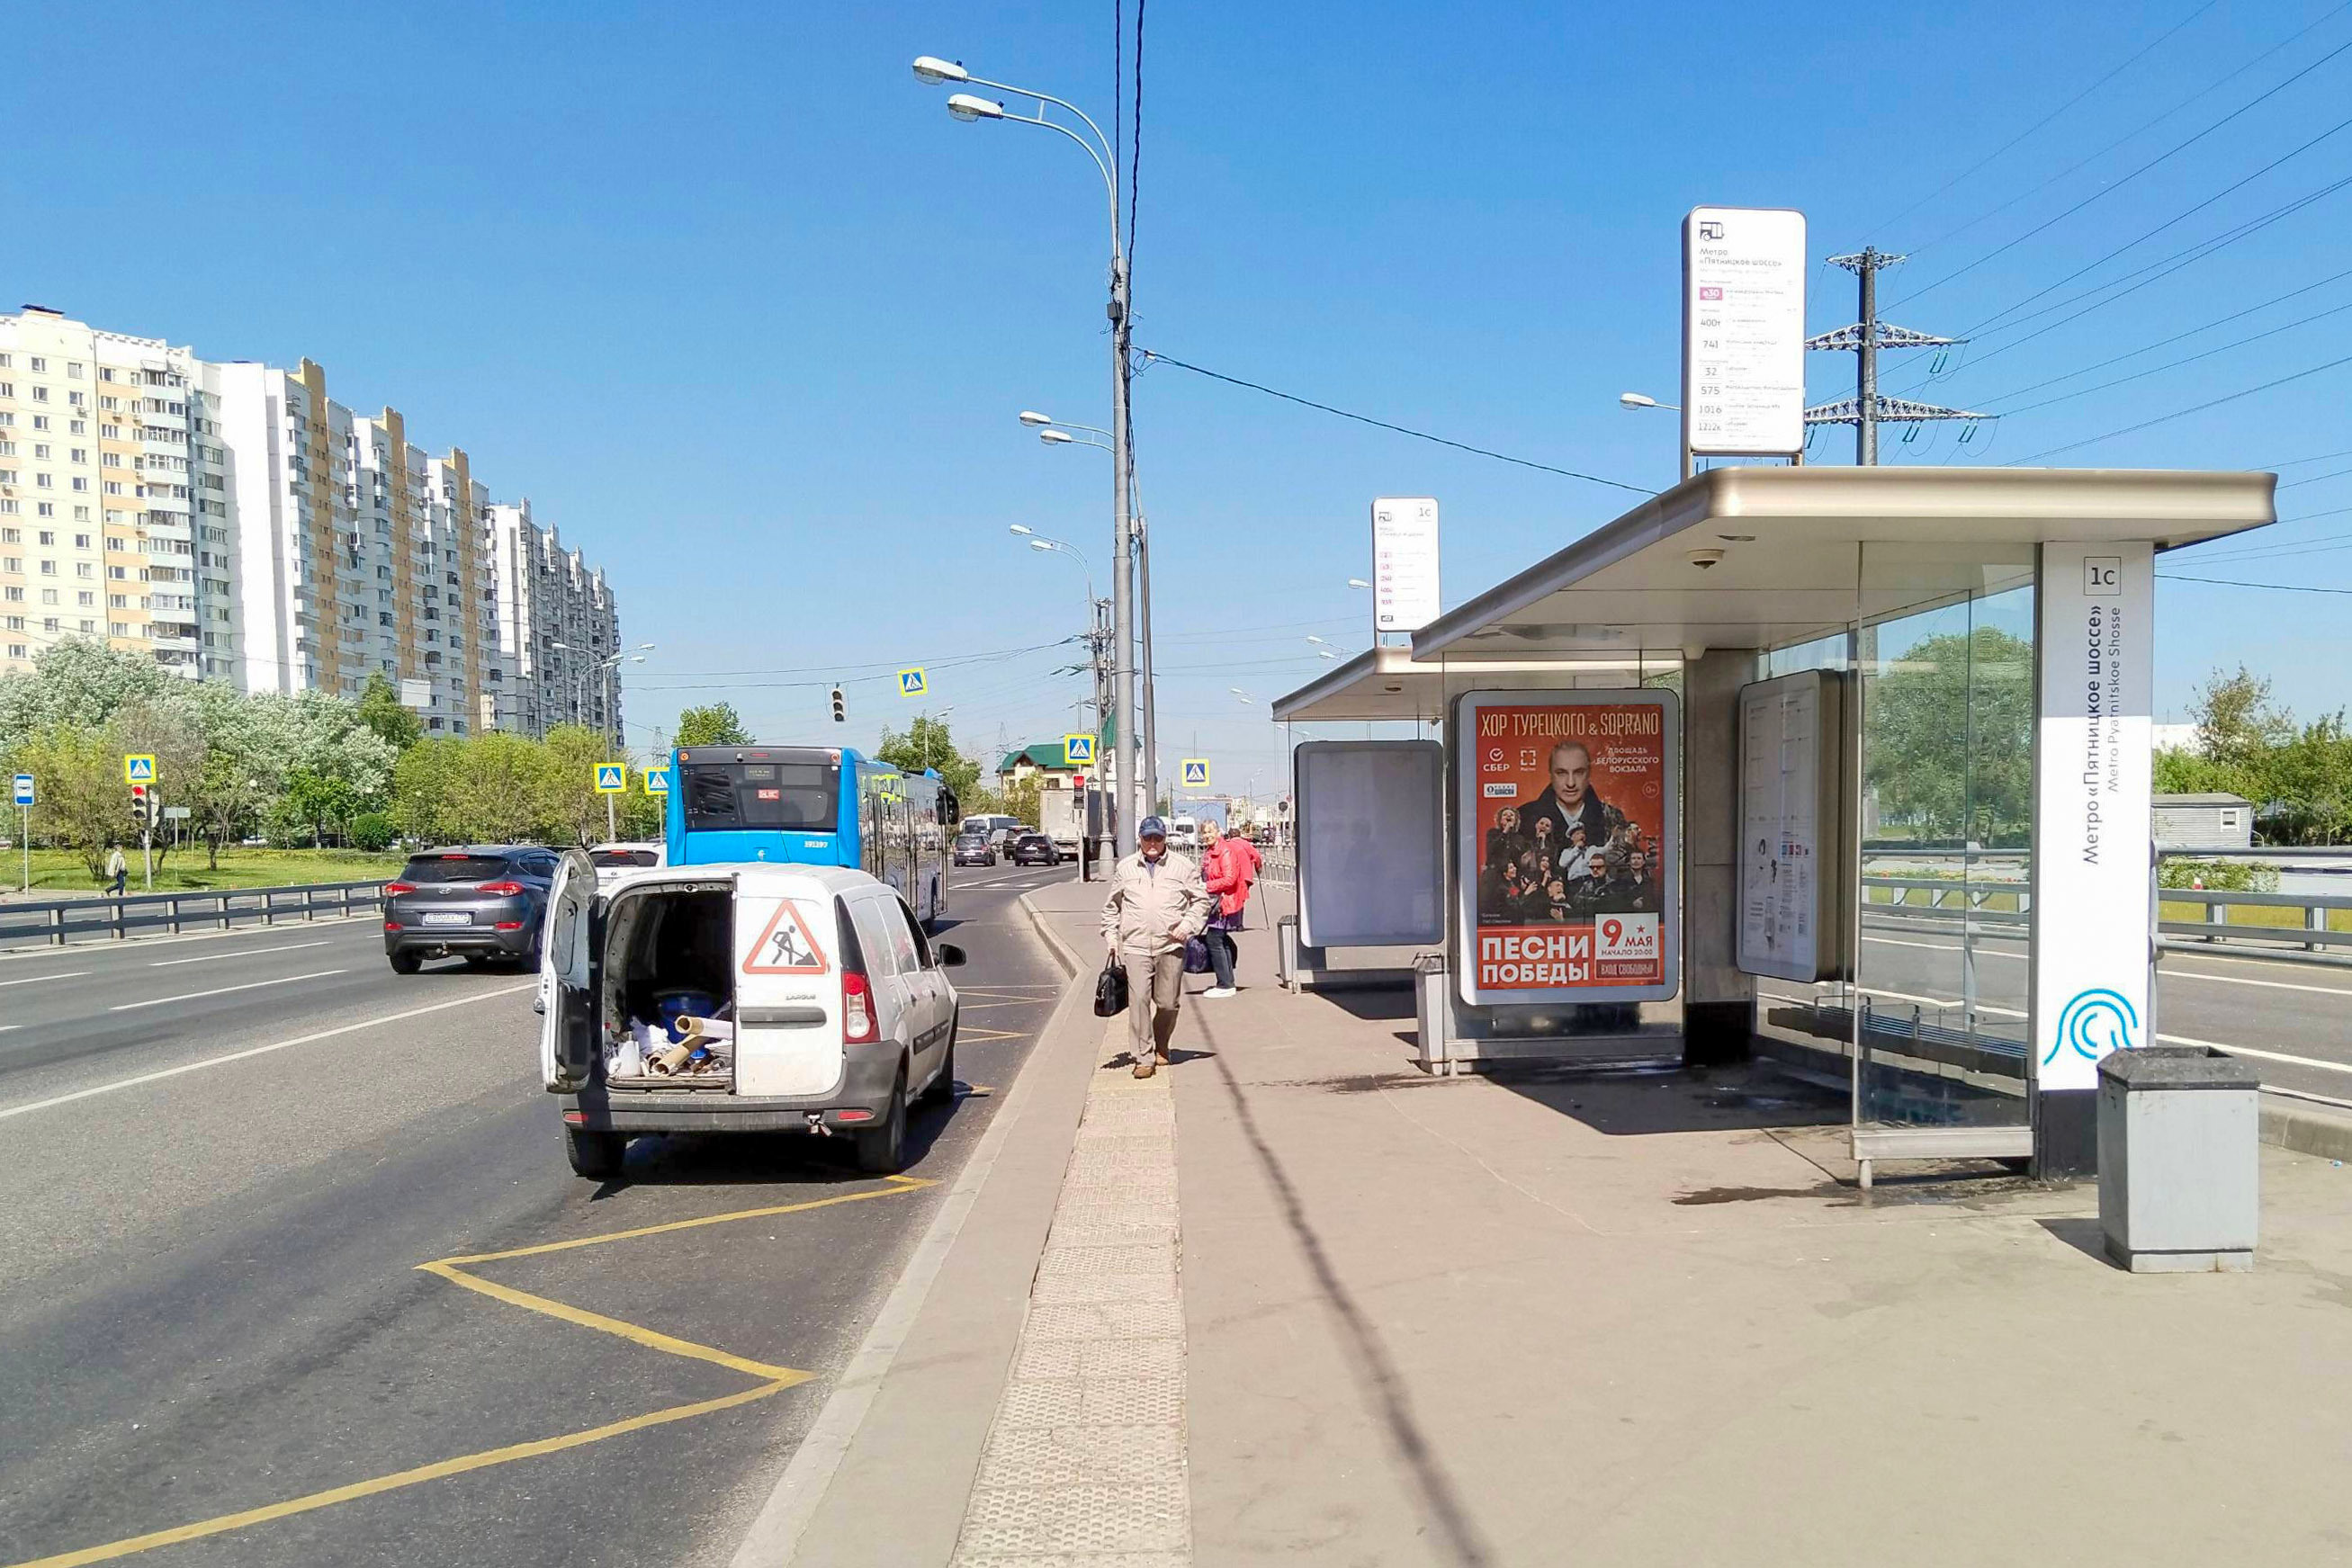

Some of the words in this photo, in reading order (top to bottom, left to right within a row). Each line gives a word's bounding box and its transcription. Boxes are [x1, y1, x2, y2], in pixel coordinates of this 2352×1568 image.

[1700, 247, 1728, 256] Метро
[1702, 340, 1719, 349] 741
[1705, 367, 1718, 376] 32
[1701, 386, 1721, 396] 575
[1699, 405, 1722, 414] 1016
[2087, 605, 2102, 676] шоссе»
[2107, 607, 2121, 657] Shosse
[2107, 661, 2123, 745] Pyatnitskoe
[1481, 713, 1508, 737] ХОР
[1513, 712, 1585, 738] ТУРЕЦКОГО
[1588, 722, 1599, 736] &
[1600, 712, 1659, 736] SOPRANO
[2083, 680, 2103, 797] «Пятницкое
[1483, 763, 1511, 772] СБЕР
[1596, 757, 1659, 766] БЕЛОРУССКОГО
[1609, 765, 1647, 773] ВОКЗАЛА
[2107, 748, 2120, 793] Metro
[2083, 800, 2103, 865] Метро
[1602, 918, 1623, 947] 9
[1624, 936, 1653, 947] МАЯ
[1482, 935, 1590, 961] ПЕСНИ
[1482, 962, 1589, 985] ПОБЕДЫ
